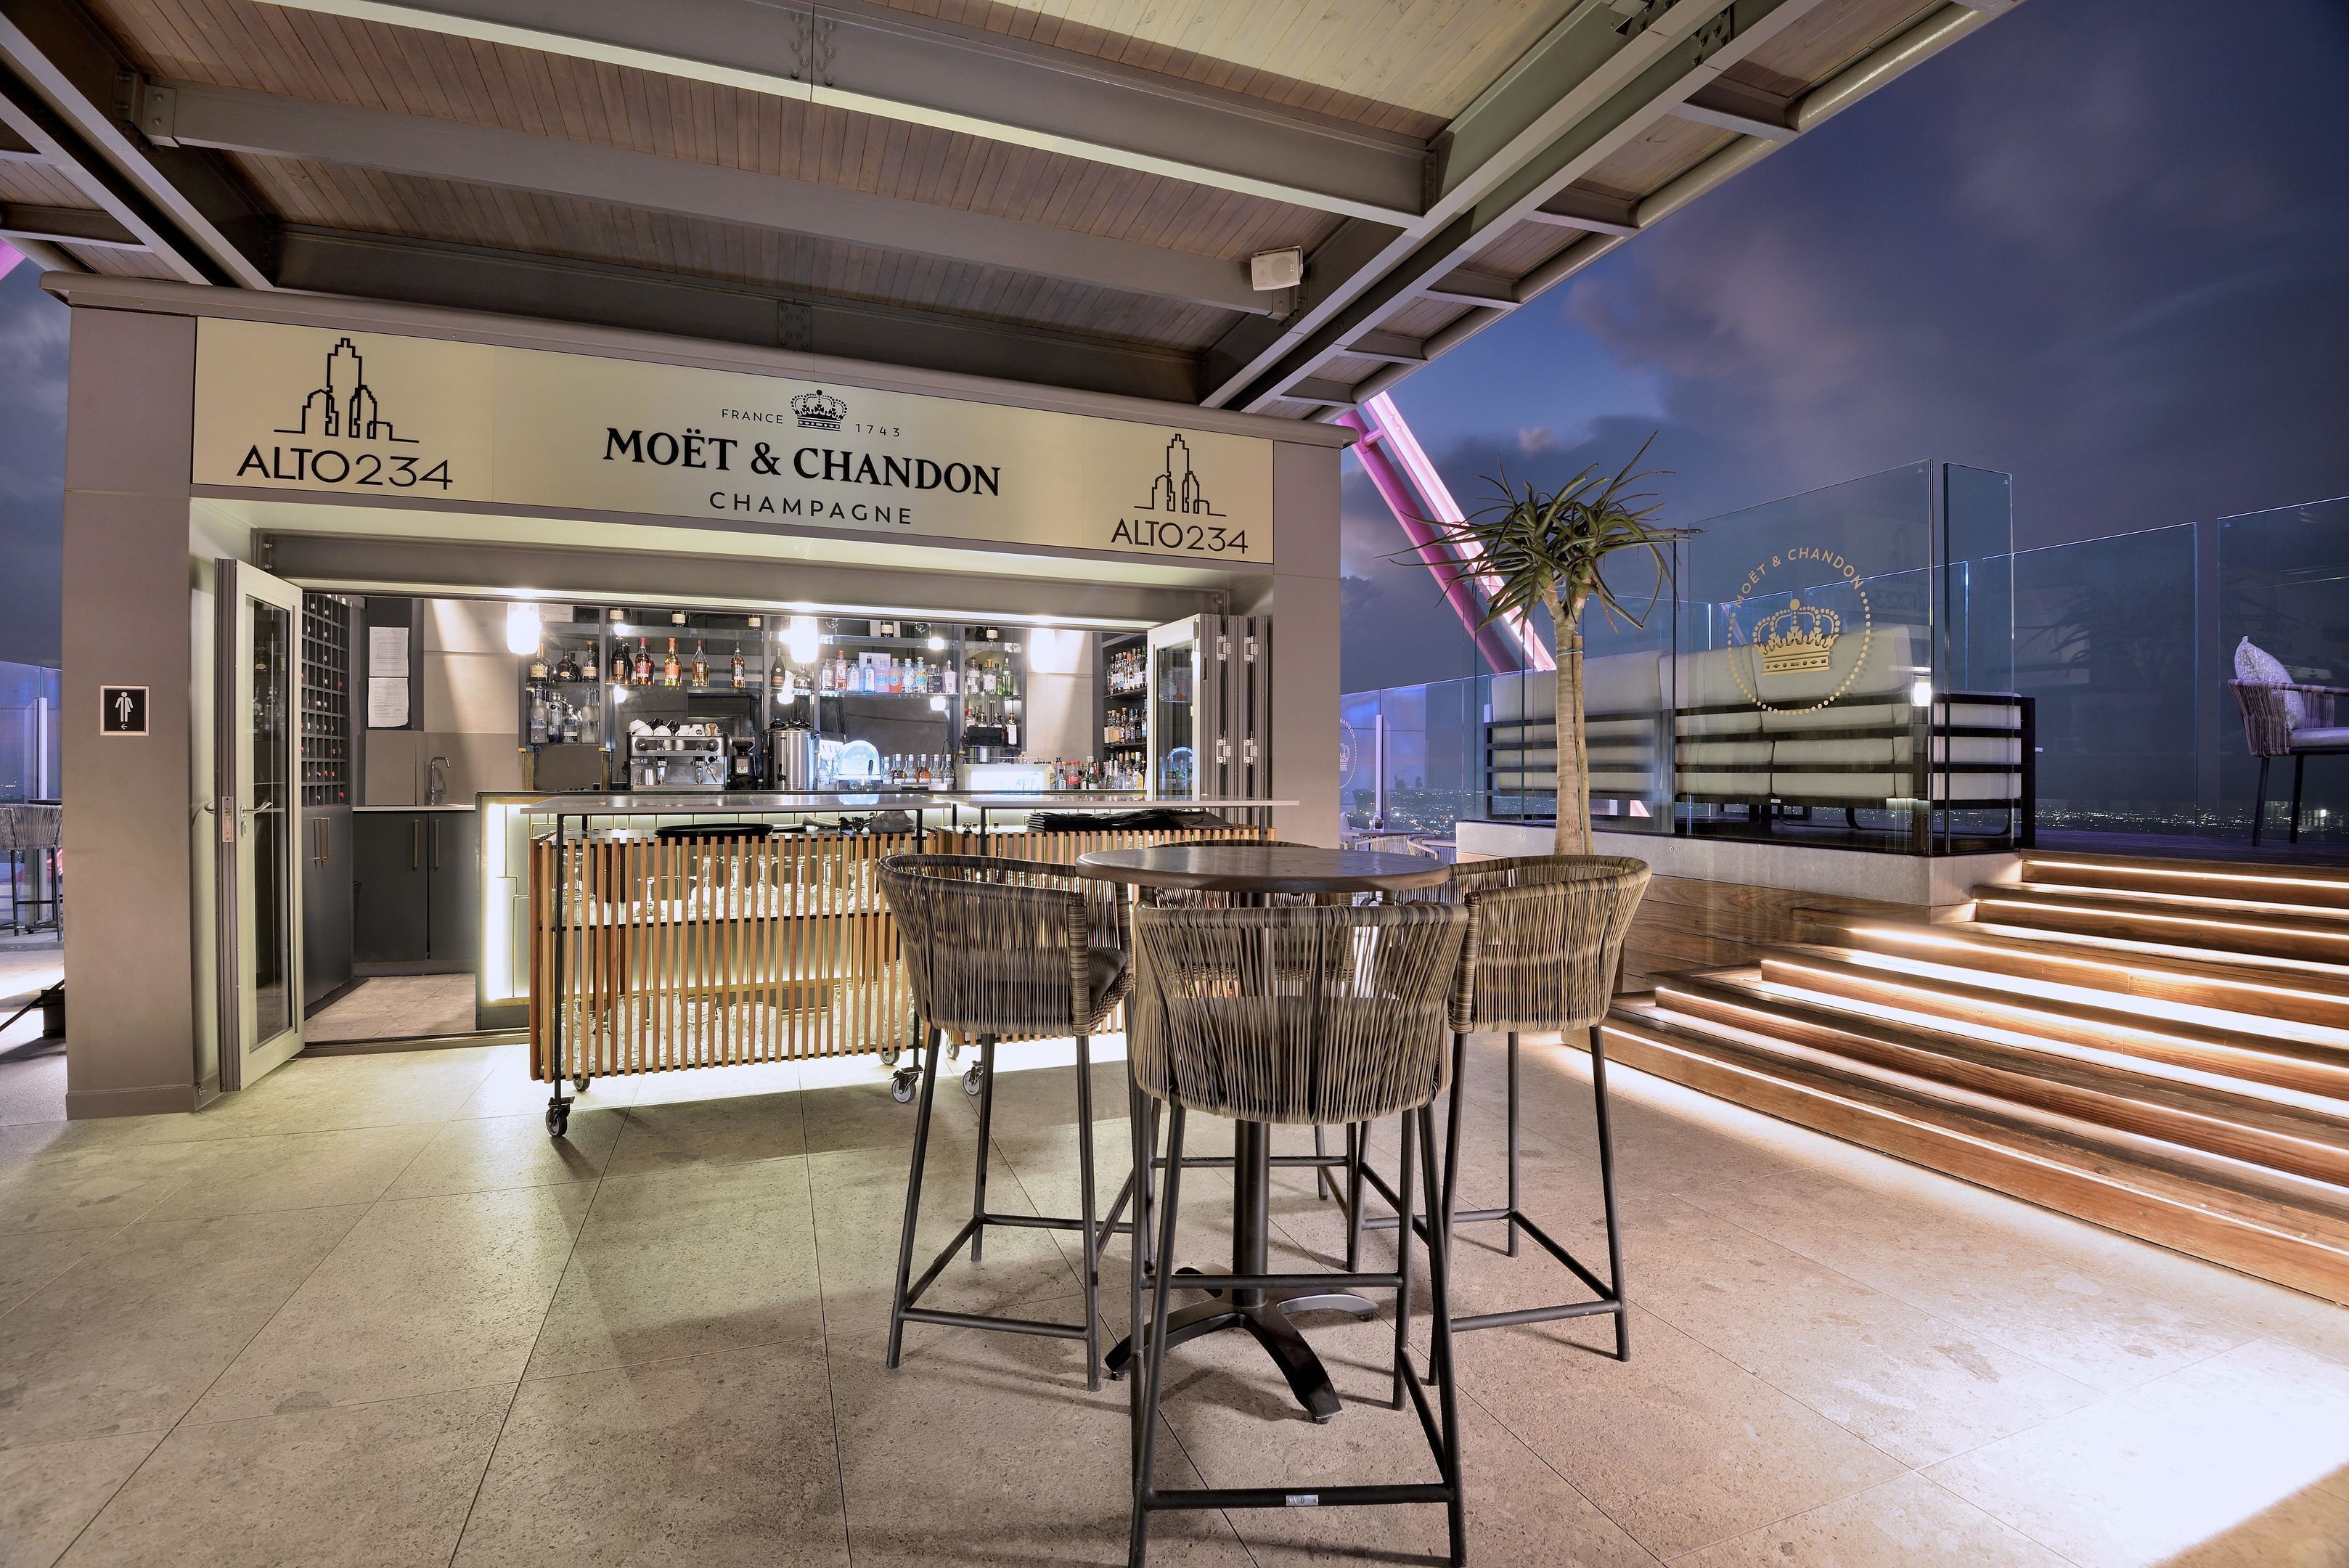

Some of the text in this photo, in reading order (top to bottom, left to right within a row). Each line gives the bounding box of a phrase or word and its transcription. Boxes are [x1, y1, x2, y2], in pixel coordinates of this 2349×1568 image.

[722, 409, 900, 437] FRANCE 1743
[236, 444, 454, 491] ALTO234
[602, 427, 1001, 497] MOËT & CHANDON
[708, 491, 912, 525] CHAMPAGNE
[1111, 518, 1249, 554] ALTO234
[1734, 547, 1864, 608] MOËT & CHANDON
[1340, 717, 1356, 739] HANDON
